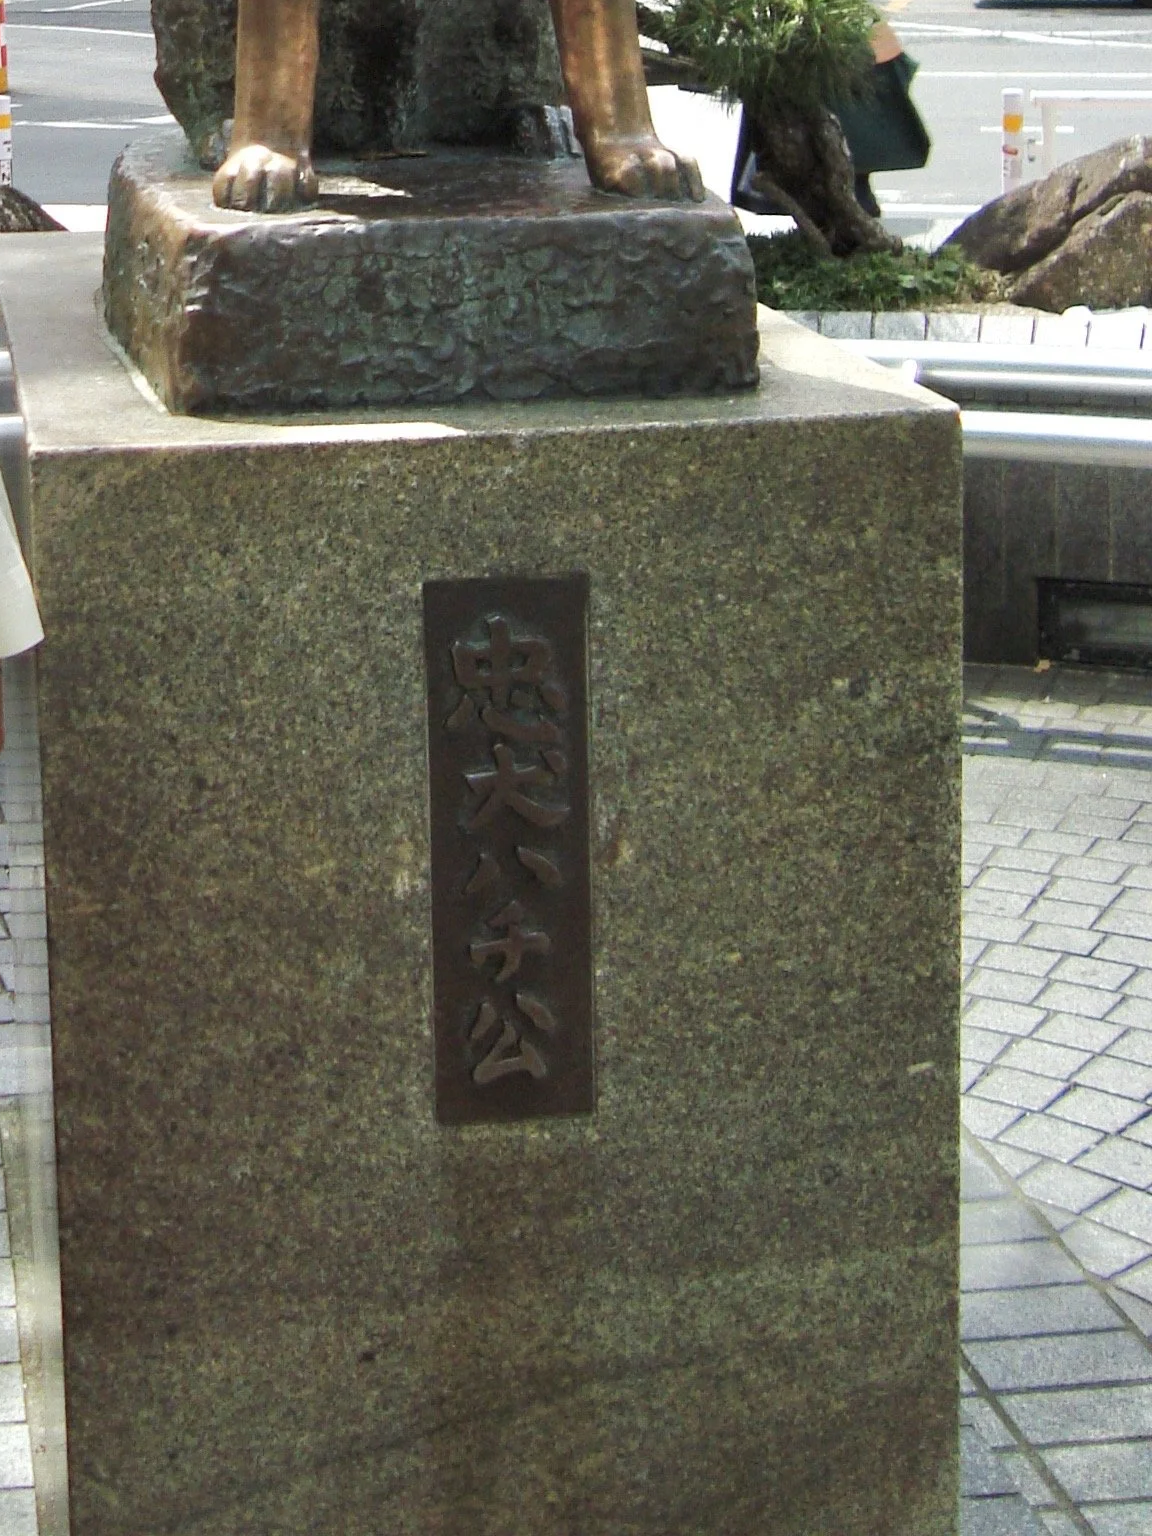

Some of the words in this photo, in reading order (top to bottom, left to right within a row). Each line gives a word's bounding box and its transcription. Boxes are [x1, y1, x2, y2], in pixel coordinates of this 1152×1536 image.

[442, 614, 571, 1085] 忠犬ハチ公
